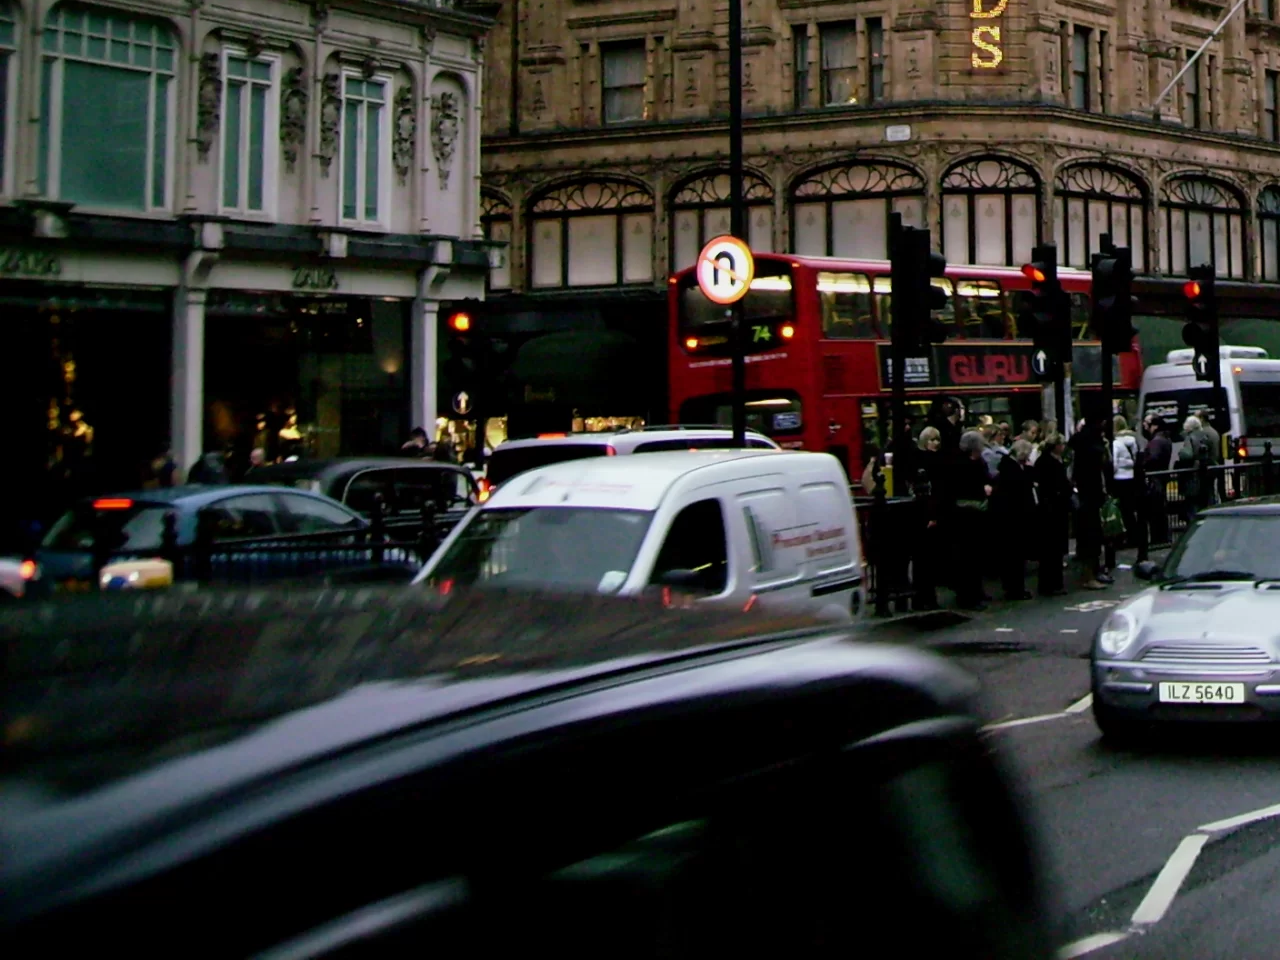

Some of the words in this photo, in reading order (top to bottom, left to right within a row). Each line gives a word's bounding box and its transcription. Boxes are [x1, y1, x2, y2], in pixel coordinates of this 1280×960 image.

[751, 325, 772, 343] 74
[948, 354, 1032, 384] GURU
[1168, 684, 1190, 700] ILZ
[1195, 685, 1234, 700] 5640
